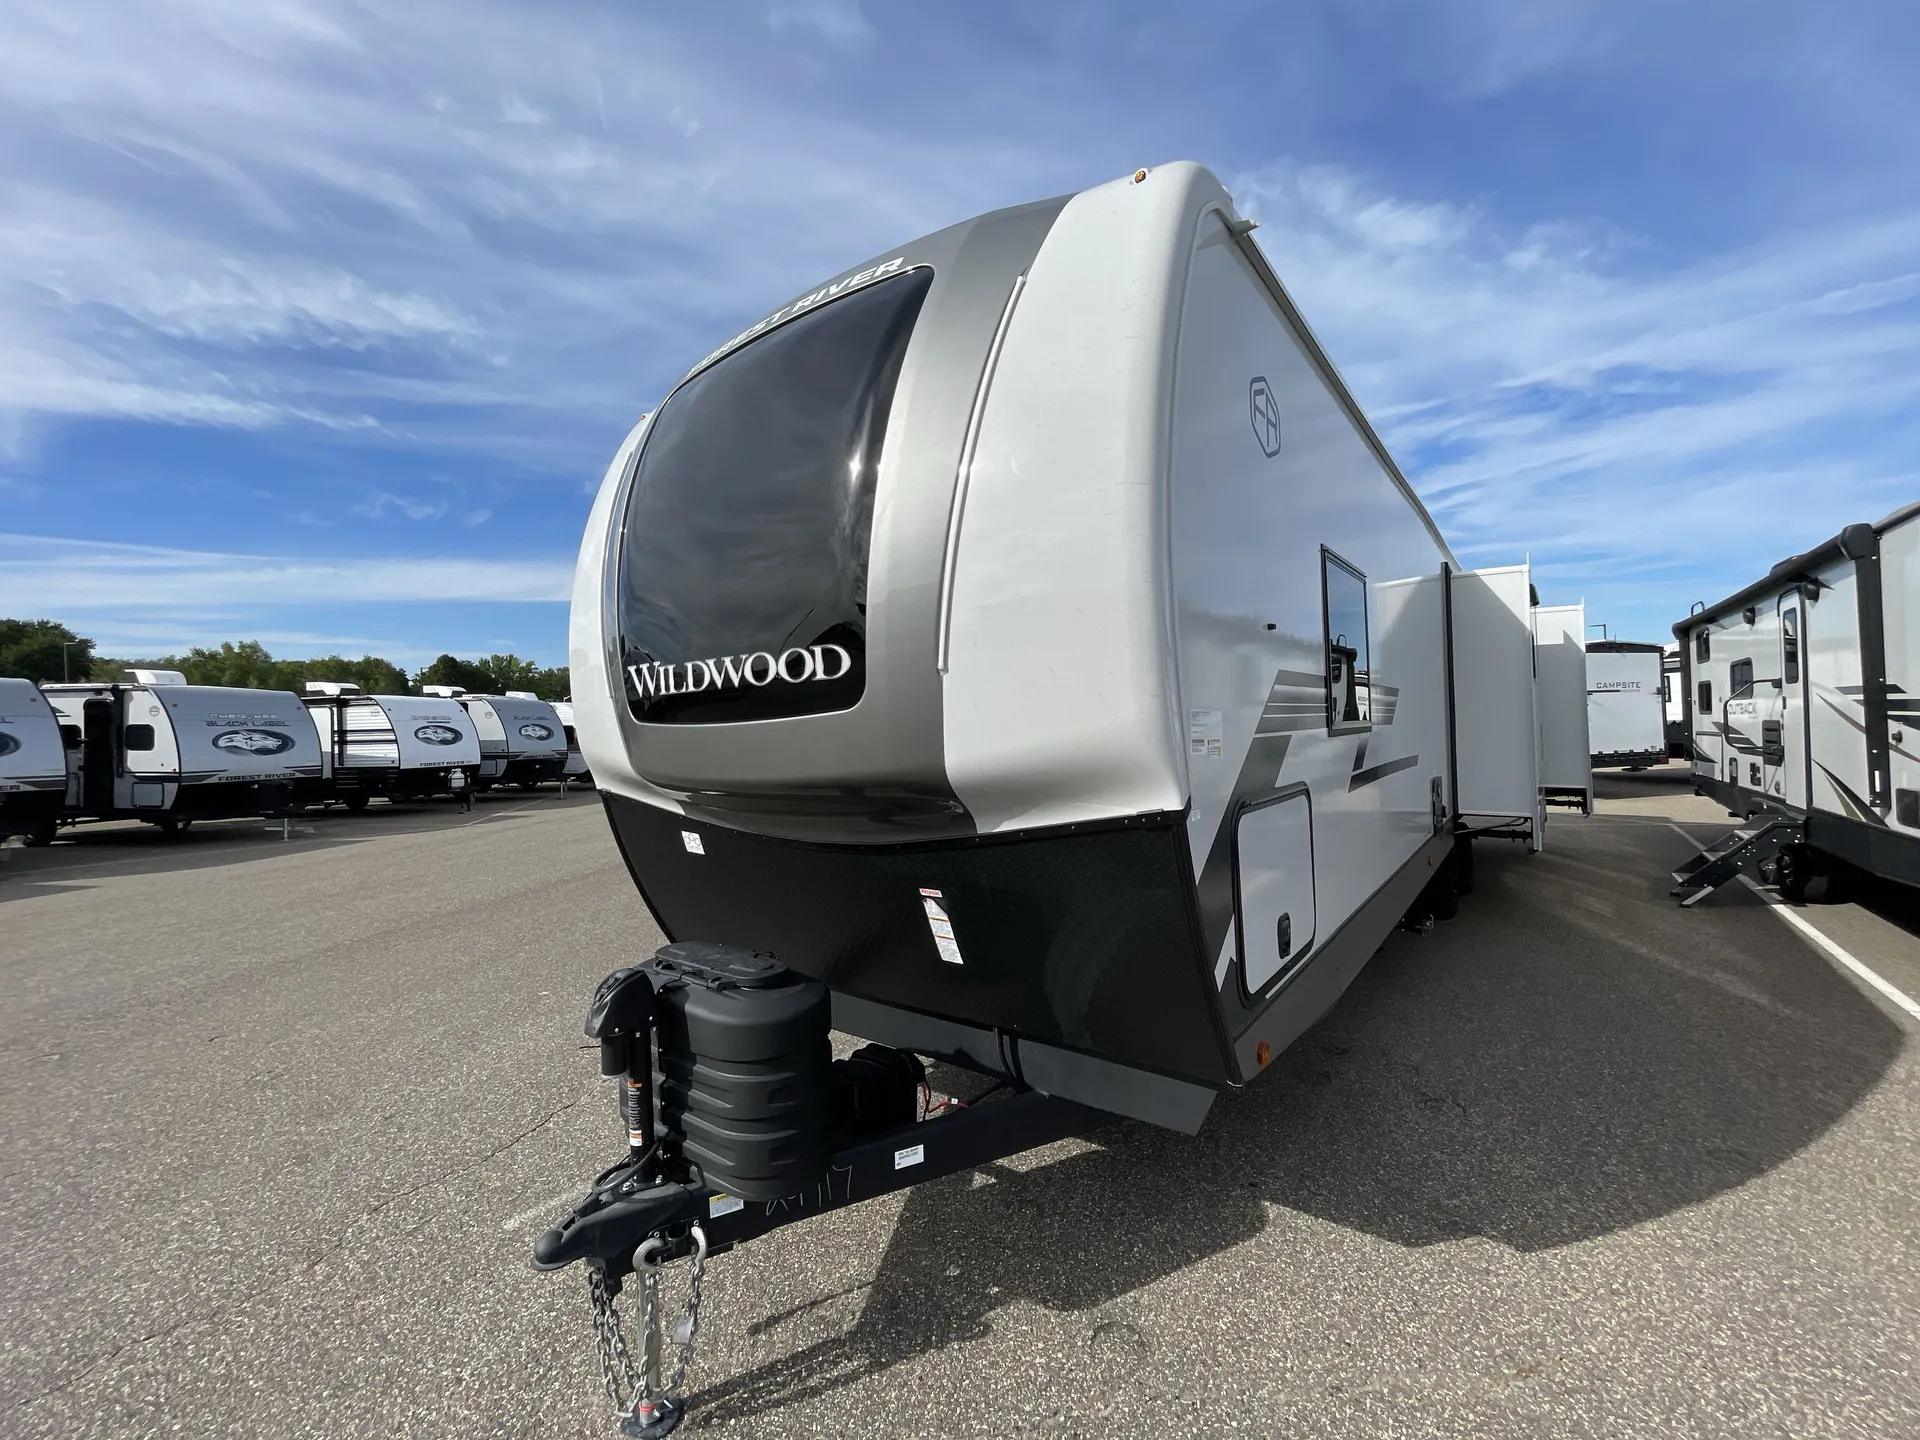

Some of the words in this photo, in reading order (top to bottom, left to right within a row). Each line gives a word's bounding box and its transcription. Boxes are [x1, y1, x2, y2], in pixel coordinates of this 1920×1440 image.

[686, 307, 790, 377] FOREST
[792, 257, 904, 313] RIVER
[628, 643, 851, 698] WILDWOOD
[1596, 681, 1641, 689] CAMPSITE
